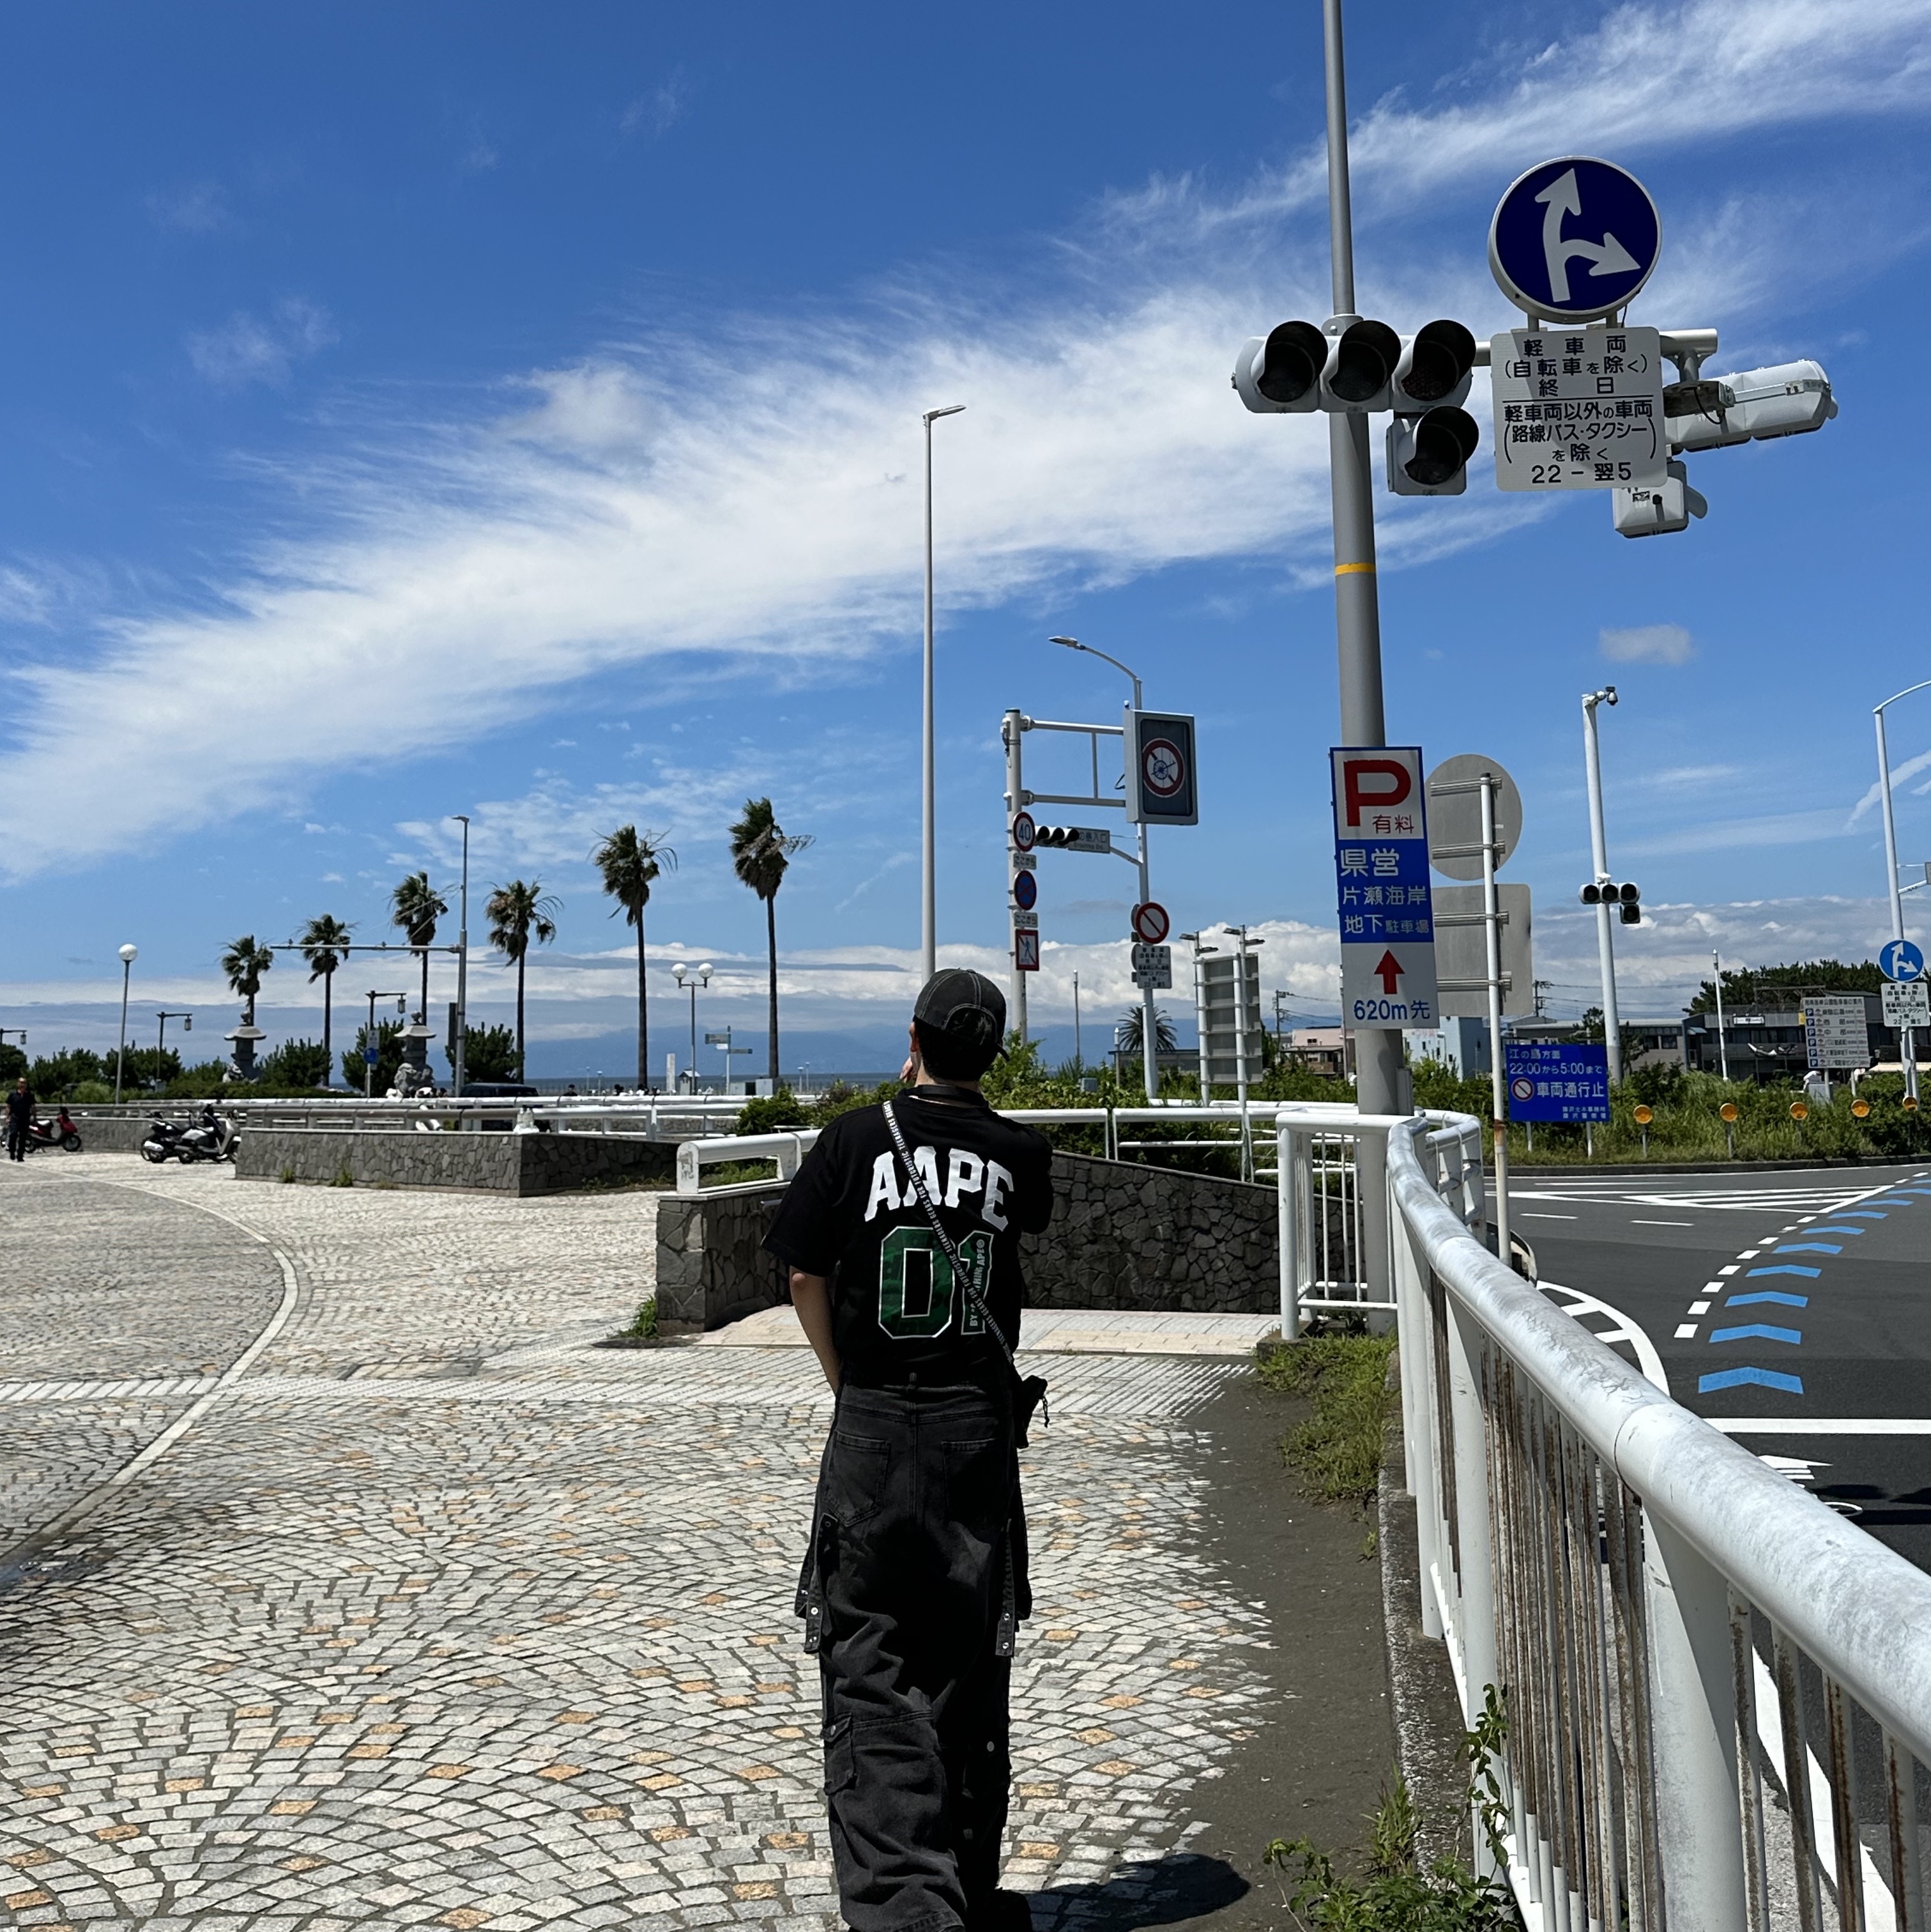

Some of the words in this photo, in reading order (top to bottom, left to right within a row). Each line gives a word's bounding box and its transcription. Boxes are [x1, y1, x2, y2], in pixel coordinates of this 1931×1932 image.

[1504, 400, 1653, 422] 軽車両以外の車両
[1343, 759, 1412, 827] P
[1018, 824, 1031, 841] 40
[1372, 814, 1414, 834] 有料
[1340, 848, 1400, 877] 県営
[1342, 885, 1428, 905] 片瀬海岸
[1536, 1082, 1605, 1098] 車両通行止
